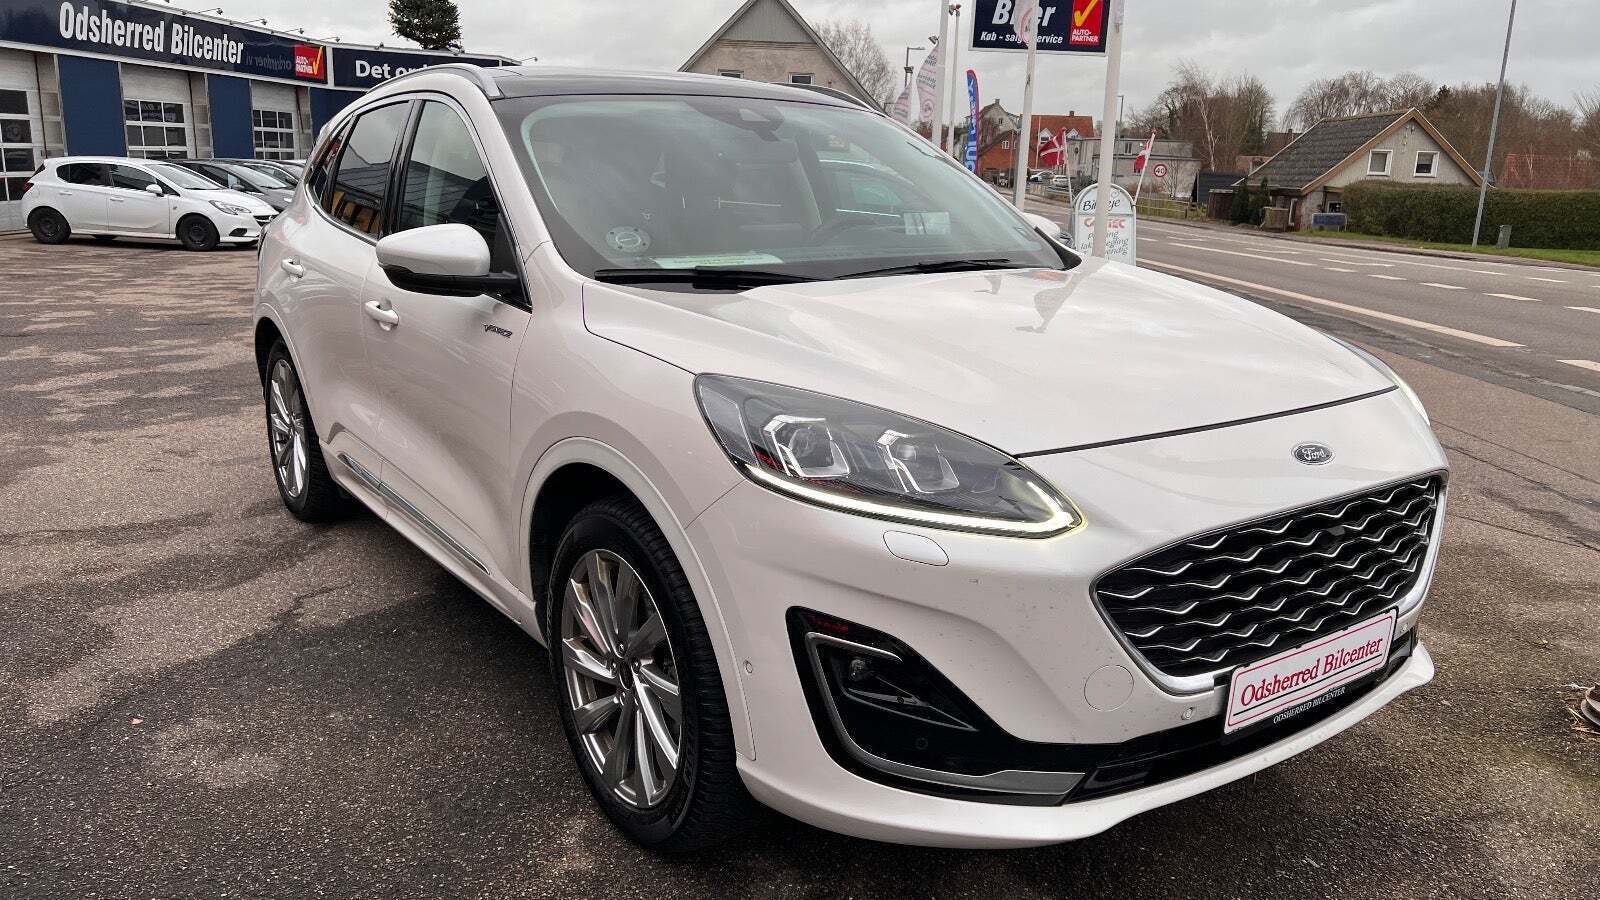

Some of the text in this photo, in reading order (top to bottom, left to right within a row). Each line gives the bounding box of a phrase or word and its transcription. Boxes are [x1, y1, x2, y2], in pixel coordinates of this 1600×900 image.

[59, 2, 244, 64] Odsherred Bilcenter
[1036, 34, 1063, 44] ervice
[1071, 35, 1099, 43] PARTNER
[355, 59, 391, 79] Det
[1301, 447, 1327, 460] Ford
[1241, 638, 1383, 706] Odsherred Bilcenter
[1273, 687, 1346, 724] ODSHERRED BILCENTER
